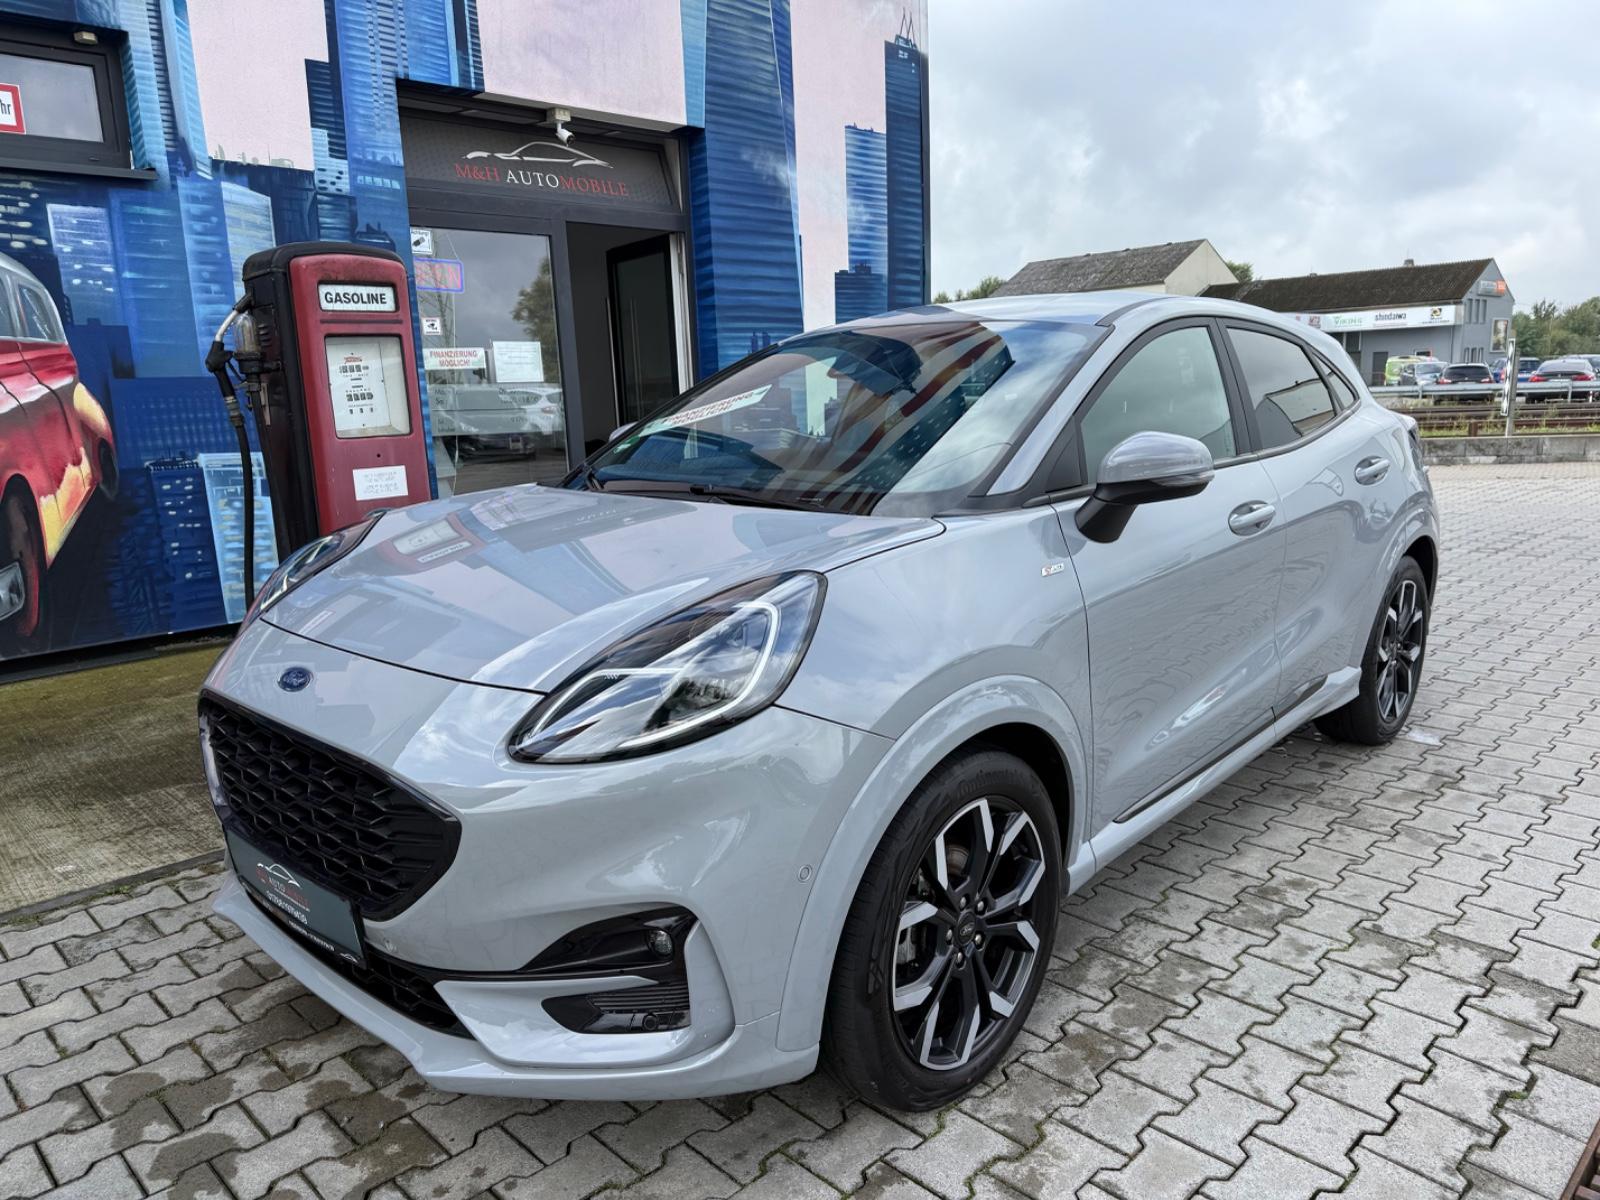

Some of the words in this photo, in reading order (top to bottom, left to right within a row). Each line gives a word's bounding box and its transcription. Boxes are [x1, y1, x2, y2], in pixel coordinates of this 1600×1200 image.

[454, 163, 501, 183] M&H
[506, 169, 629, 197] AUTOMOBILE
[324, 291, 388, 305] GASOLINE
[429, 350, 478, 358] FINANZIERUNG
